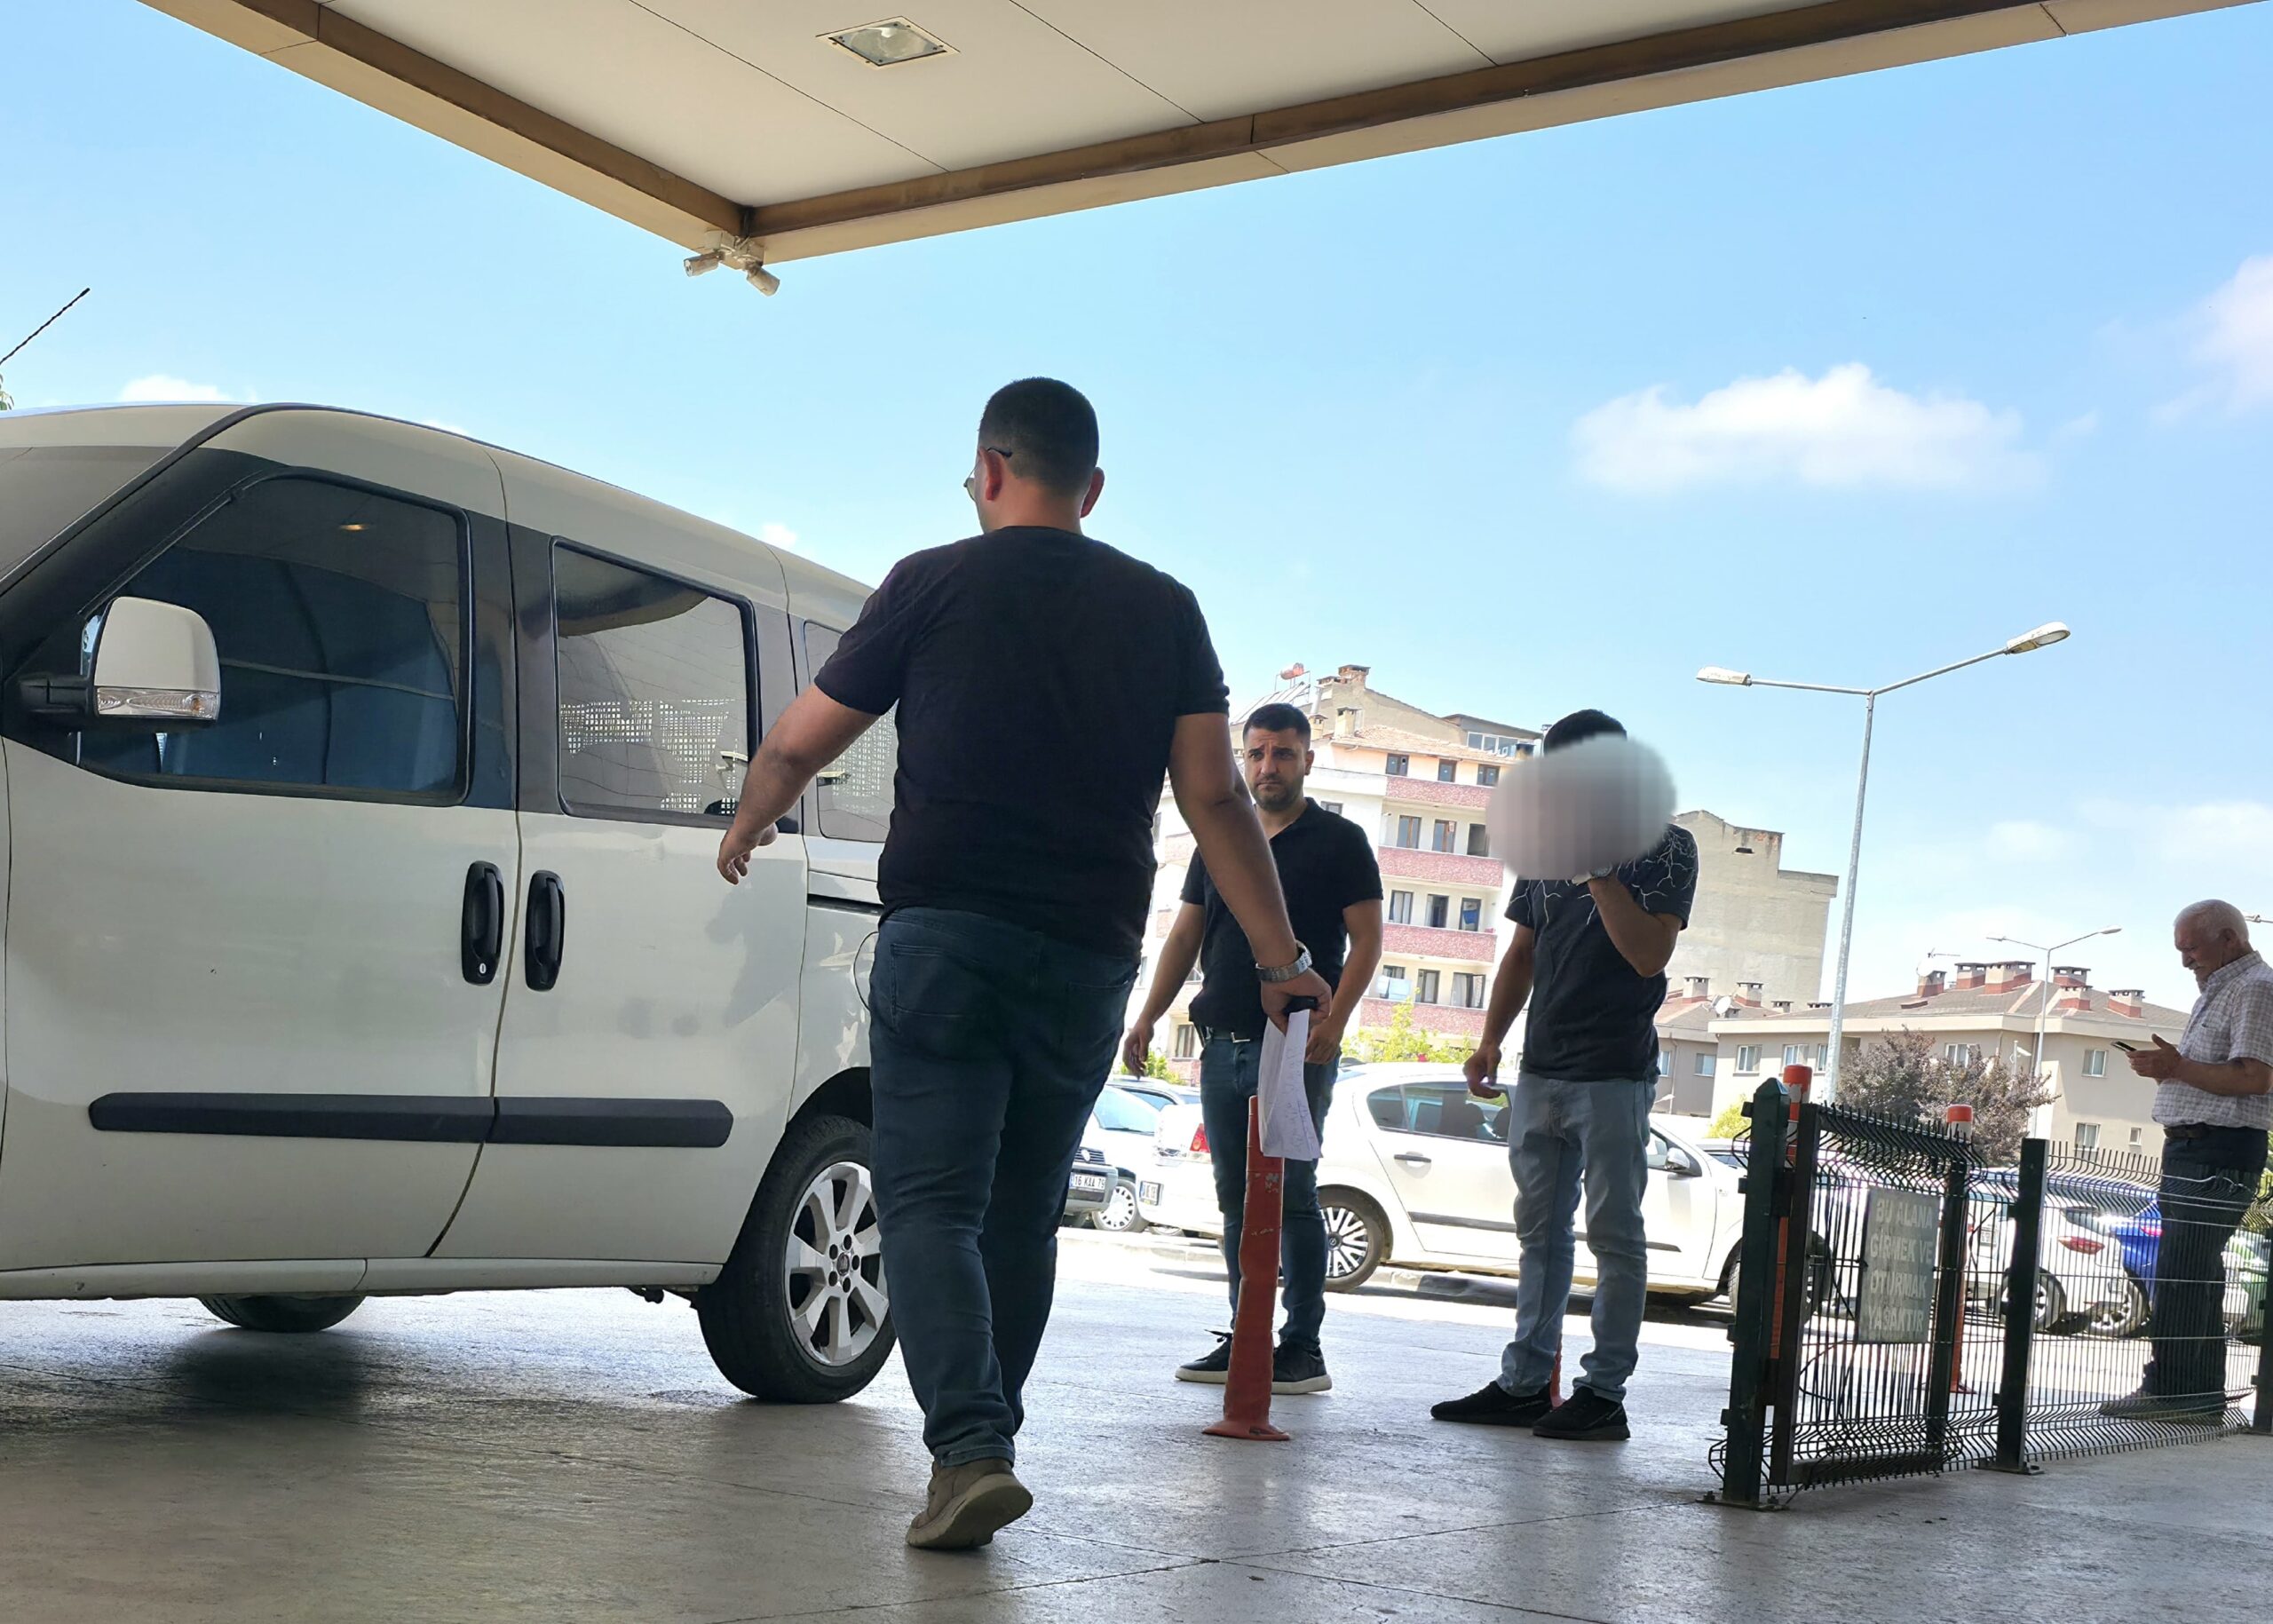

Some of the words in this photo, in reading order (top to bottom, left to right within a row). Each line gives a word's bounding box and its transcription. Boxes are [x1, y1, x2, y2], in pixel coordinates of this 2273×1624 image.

[1875, 1199, 1893, 1224] BU
[1896, 1201, 1933, 1229] ALANA
[1919, 1240, 1933, 1264] VE
[1870, 1269, 1927, 1298] OTURMAK
